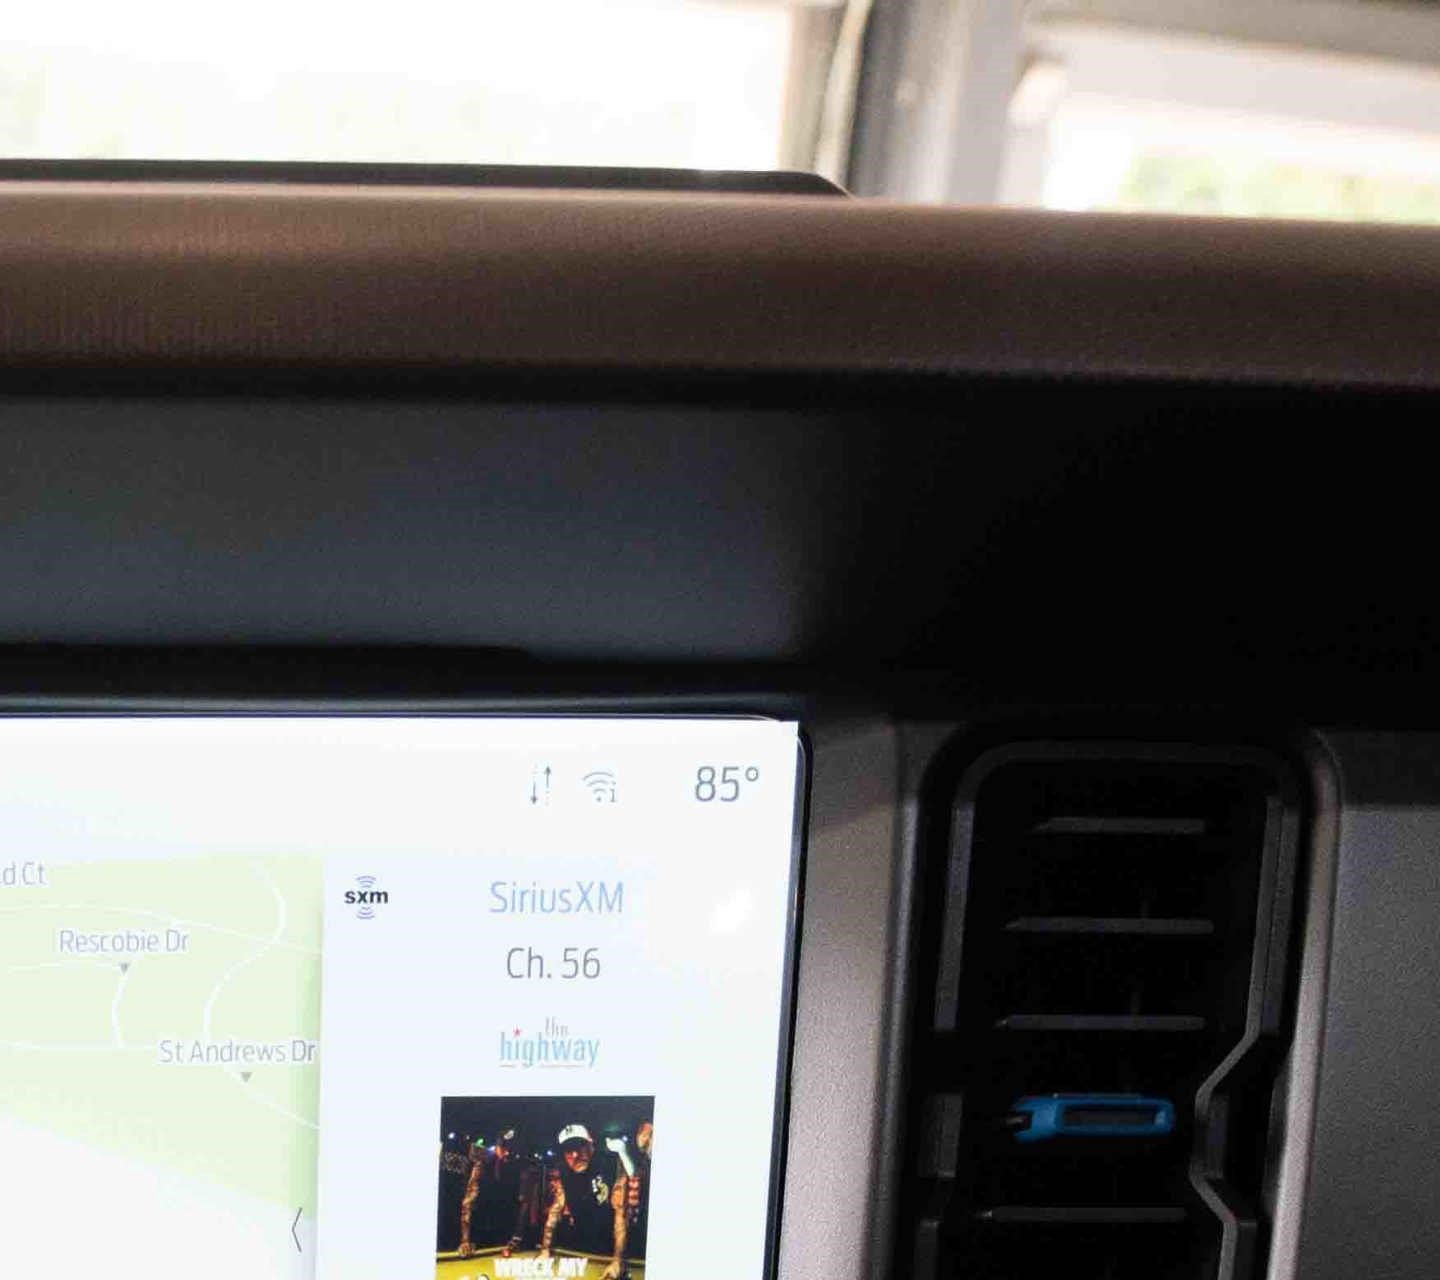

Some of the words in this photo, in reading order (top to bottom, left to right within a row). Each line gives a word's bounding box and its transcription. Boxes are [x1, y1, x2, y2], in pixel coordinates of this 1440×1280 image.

[694, 766, 760, 803] 85°
[21, 862, 47, 886] Ct
[343, 886, 390, 906] sxm
[488, 880, 624, 914] SiriusXM
[59, 929, 160, 954] Rescobie
[165, 929, 190, 953] Dr
[505, 946, 553, 980] Ch.
[560, 946, 602, 980] 56
[158, 1039, 186, 1064] St
[190, 1039, 287, 1064] Andrews
[291, 1039, 316, 1063] Dr
[499, 1031, 600, 1069] highway
